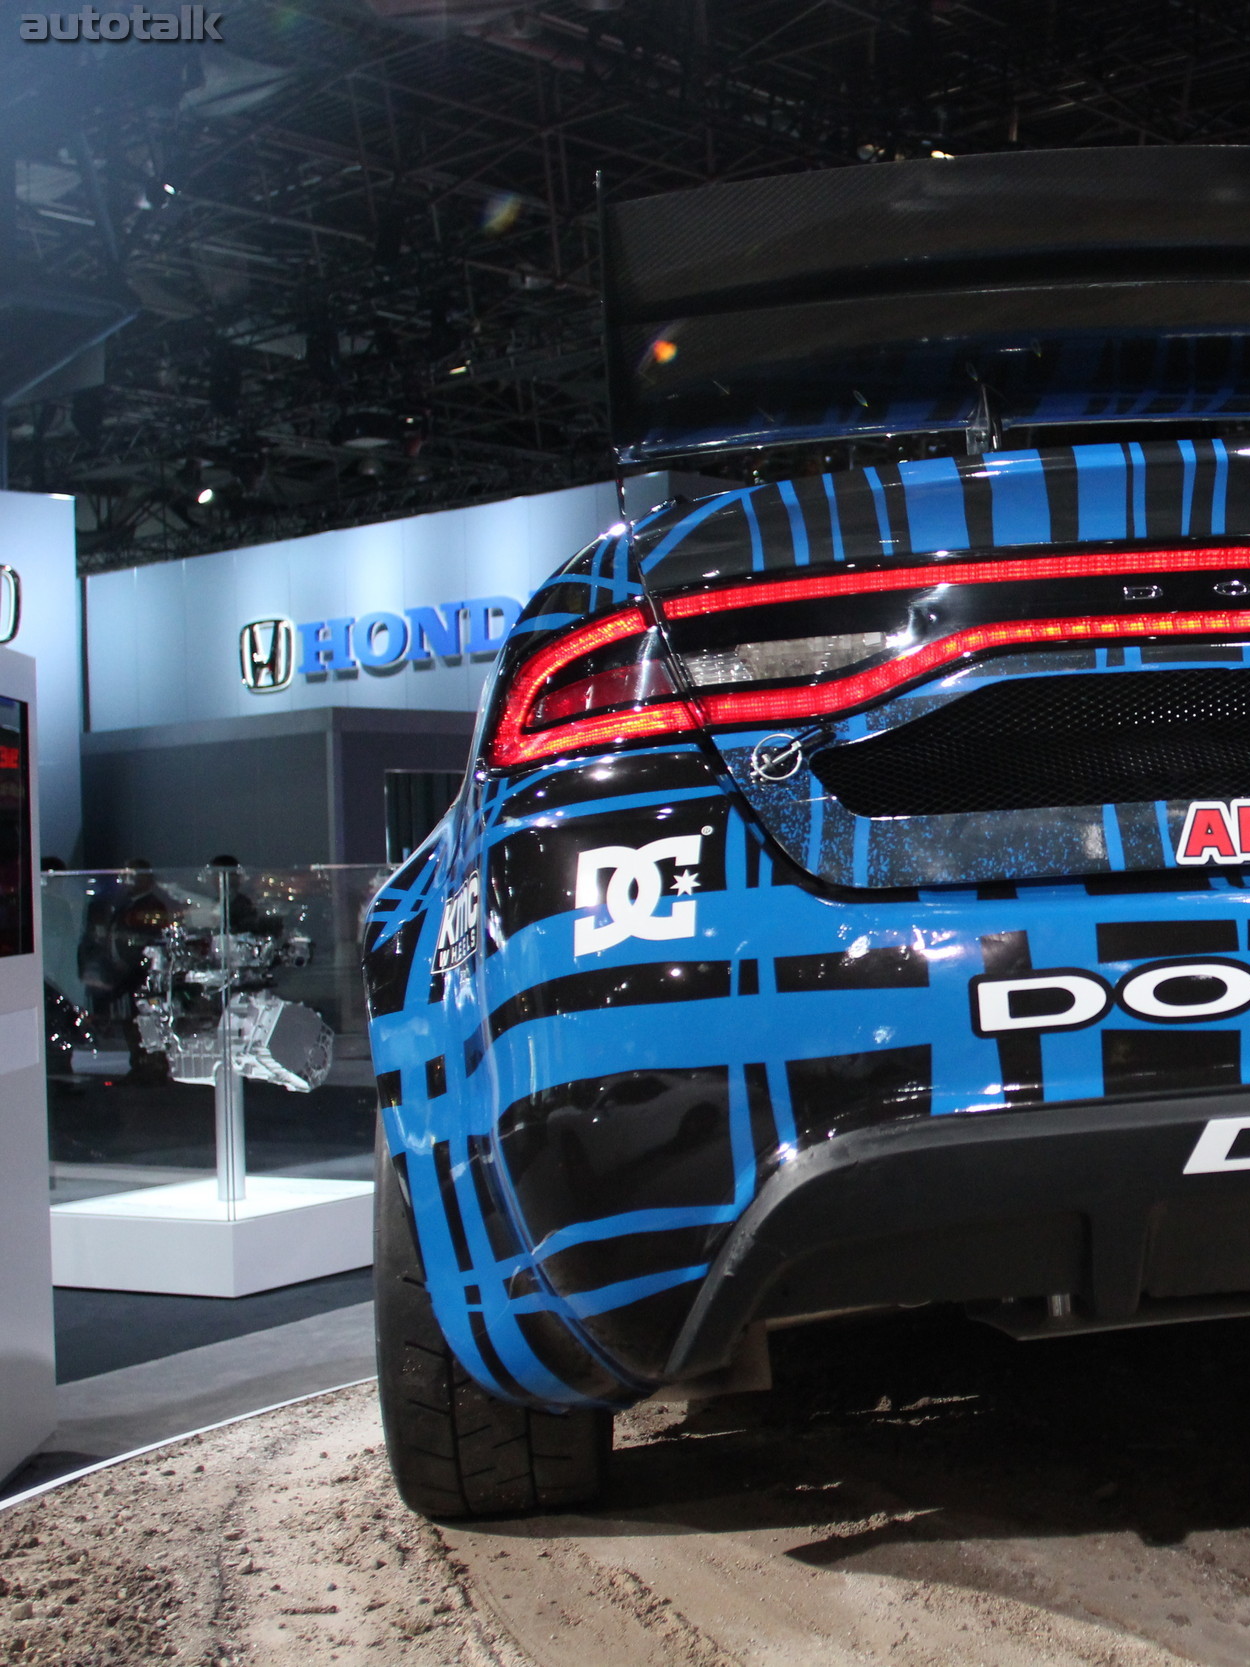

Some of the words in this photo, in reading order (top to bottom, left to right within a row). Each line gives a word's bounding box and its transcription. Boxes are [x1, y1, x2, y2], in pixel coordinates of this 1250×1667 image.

[297, 595, 526, 674] HOND
[574, 834, 702, 957] DC
[438, 928, 477, 969] WHEELS
